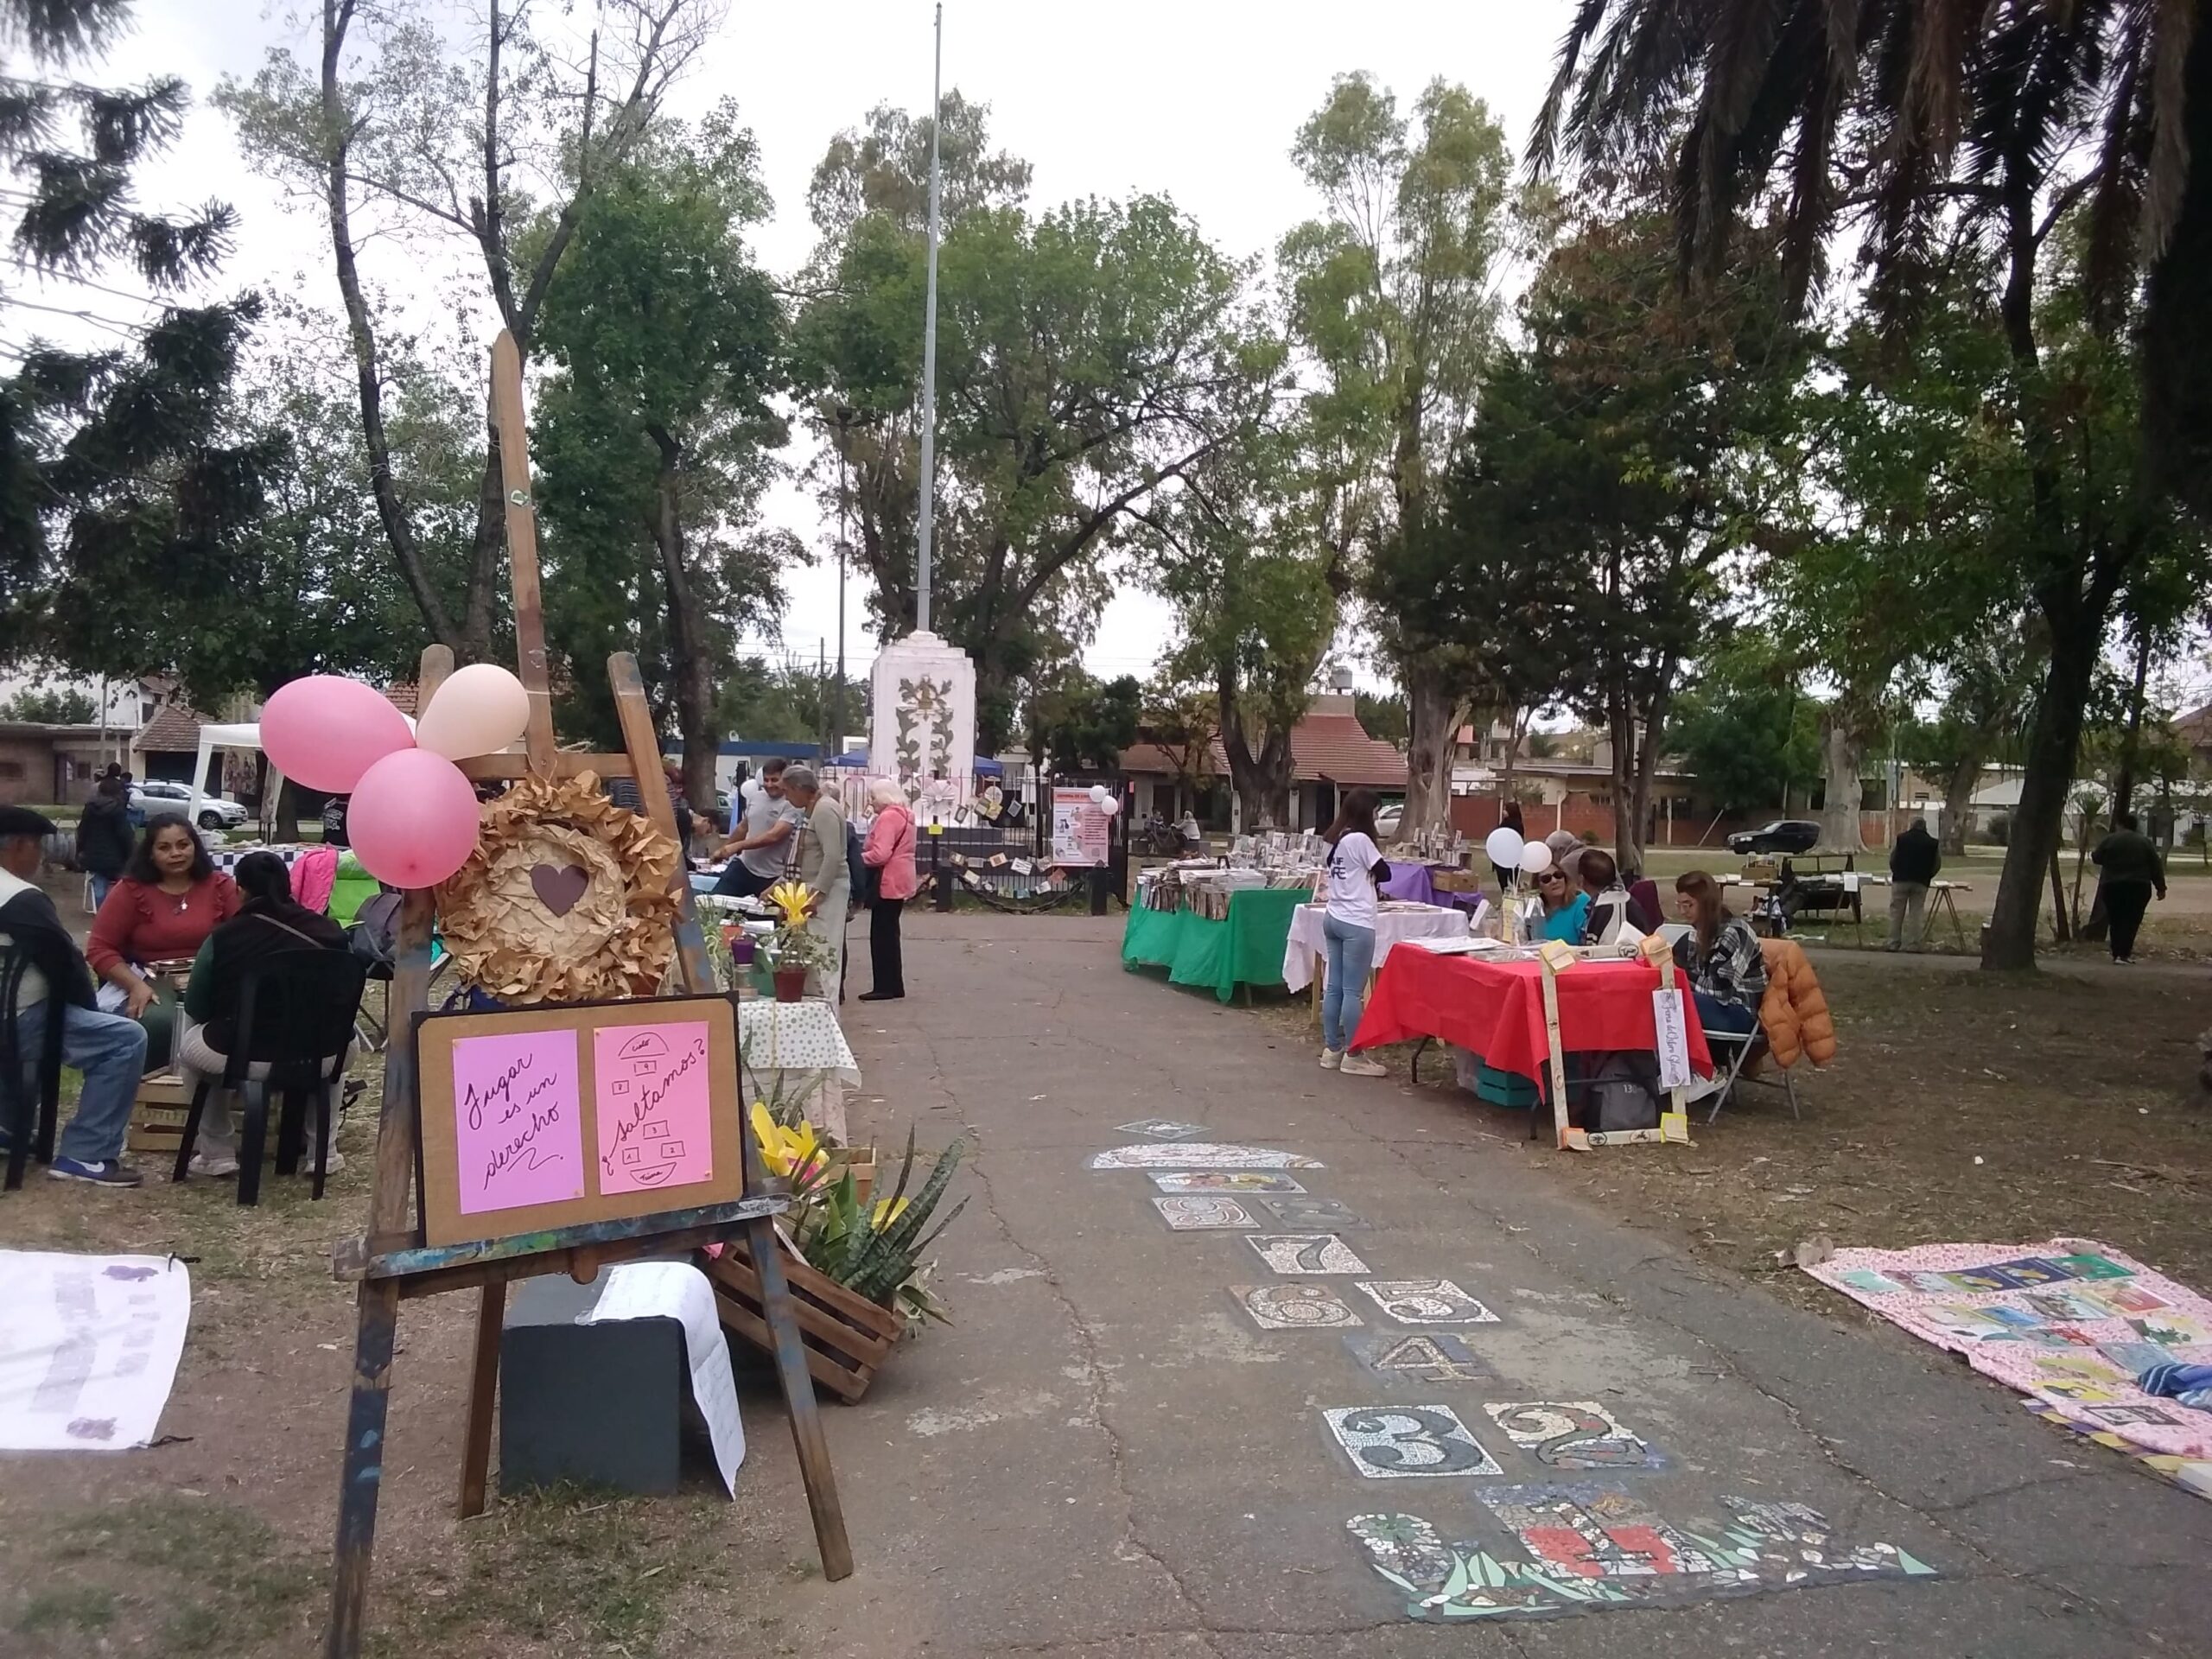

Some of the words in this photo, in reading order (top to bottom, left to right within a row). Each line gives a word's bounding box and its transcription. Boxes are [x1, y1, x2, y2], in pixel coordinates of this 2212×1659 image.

[464, 1052, 533, 1130] Jugar
[498, 1103, 522, 1124] es
[525, 1072, 557, 1105] un
[483, 1101, 560, 1191] derecho
[1252, 1236, 1332, 1271] 7
[1249, 1284, 1352, 1325] 6
[1368, 1281, 1482, 1320] 5
[1370, 1335, 1493, 1382] 4
[1344, 1407, 1484, 1472] 3
[1496, 1404, 1647, 1469] 2
